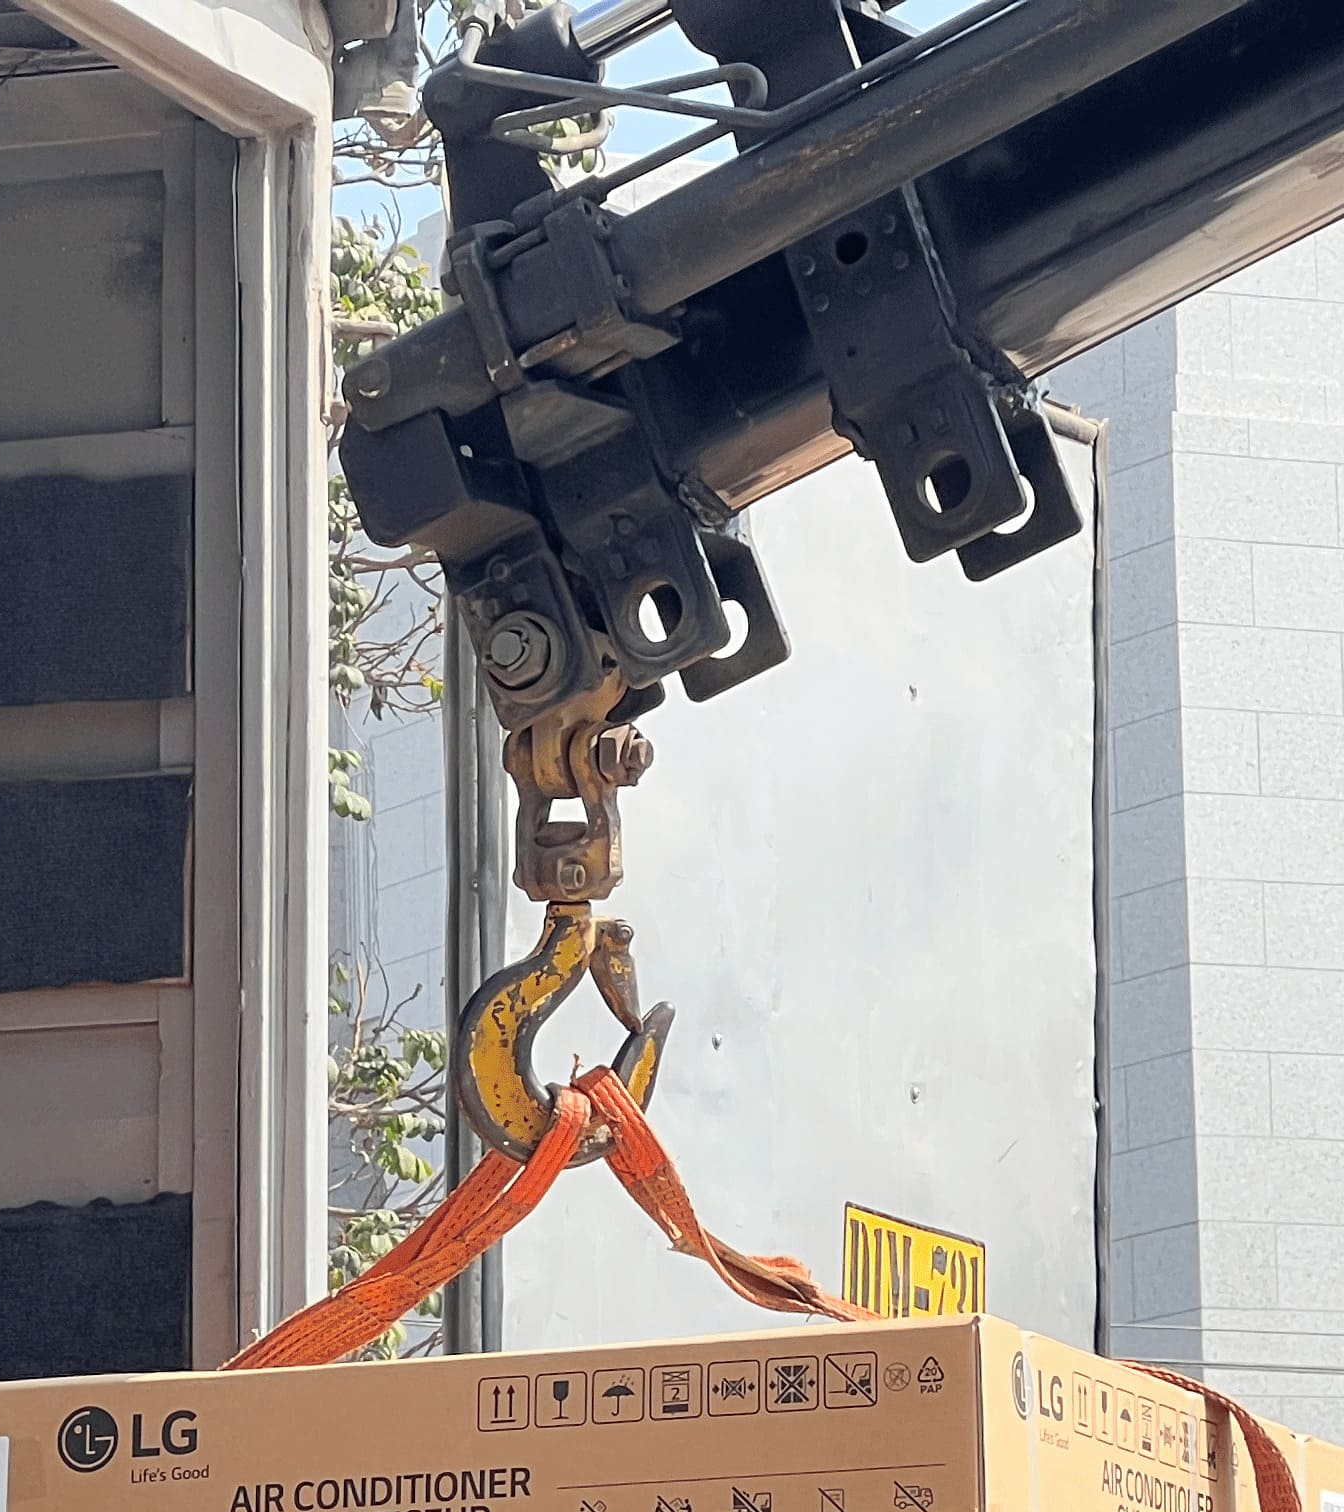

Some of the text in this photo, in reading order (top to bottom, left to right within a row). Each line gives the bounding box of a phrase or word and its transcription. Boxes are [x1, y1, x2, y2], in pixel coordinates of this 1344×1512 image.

[920, 1384, 942, 1394] PAP
[1038, 1370, 1063, 1421] LG
[131, 1410, 198, 1458] LG
[131, 1464, 209, 1484] Life's Good
[294, 1467, 532, 1512] CONDITIONER
[1102, 1460, 1124, 1497] AIR
